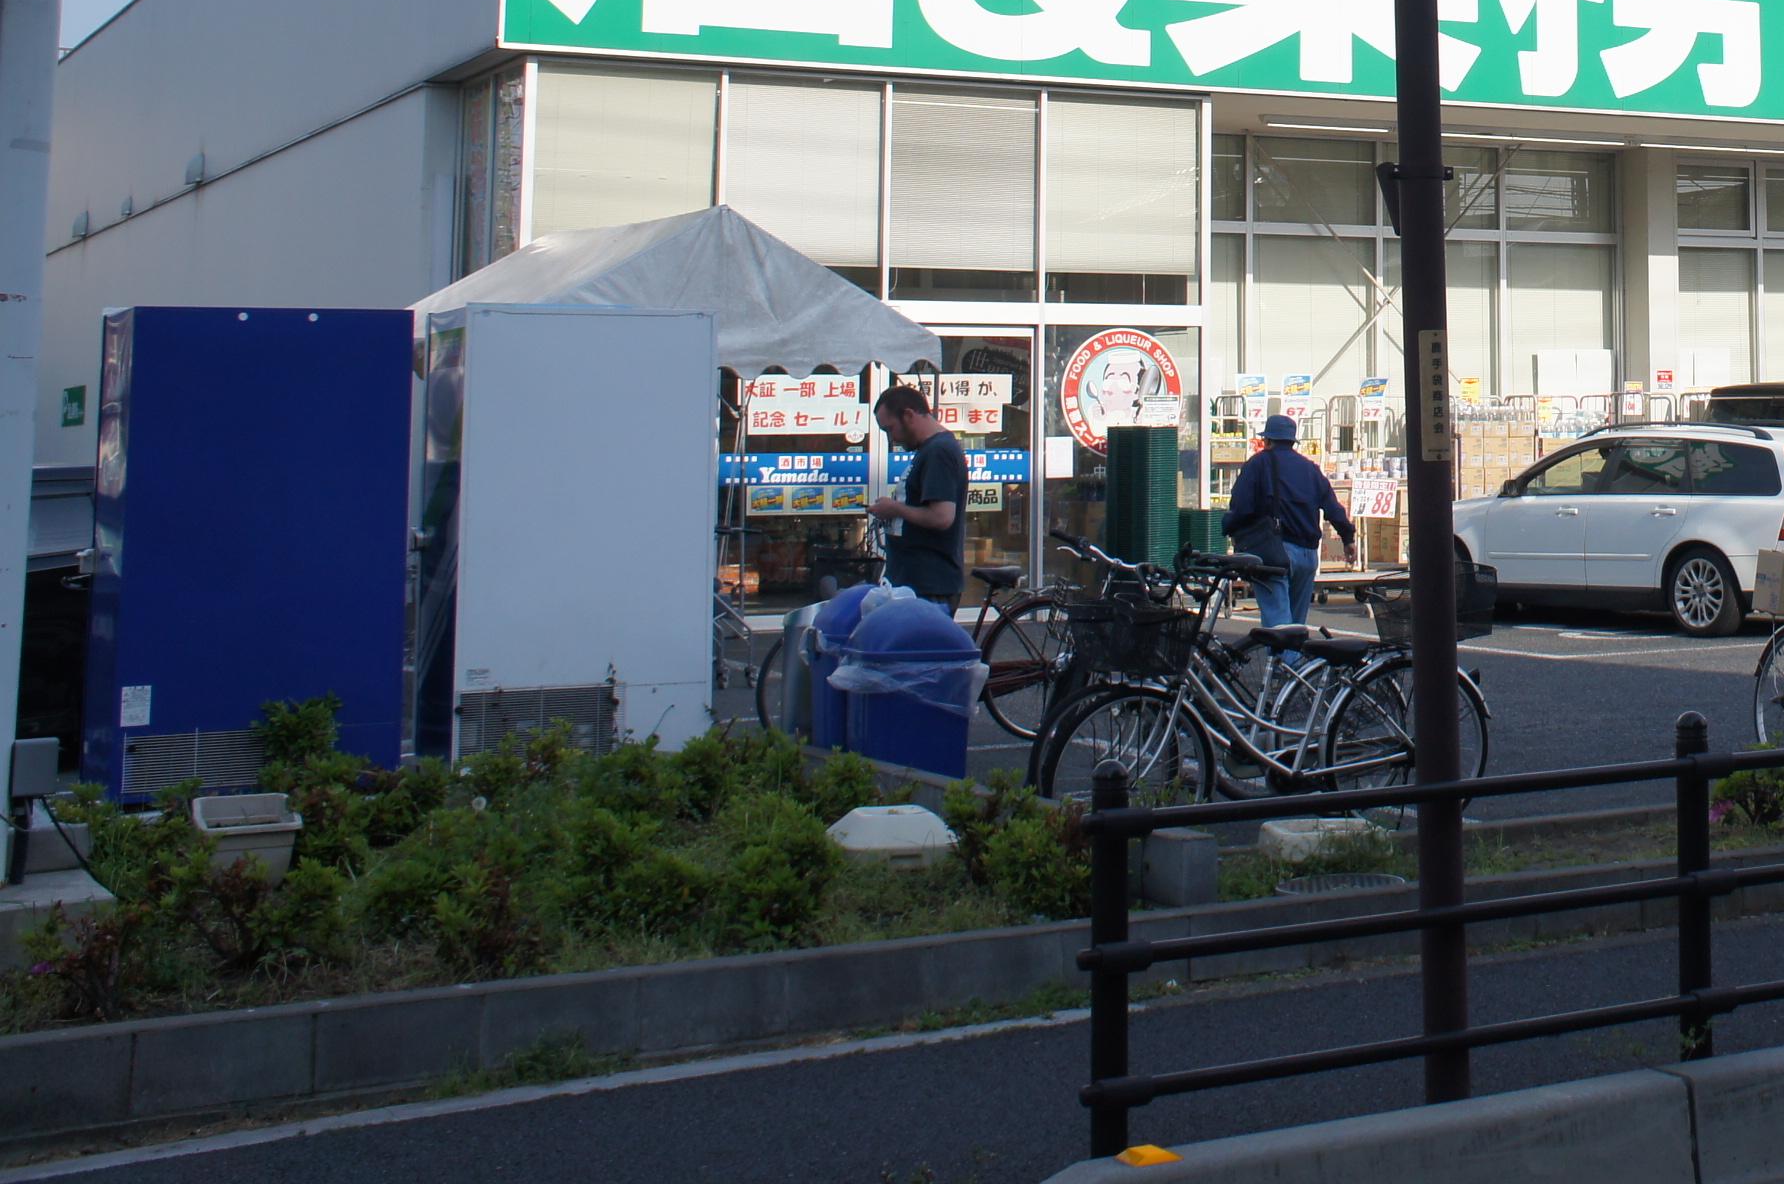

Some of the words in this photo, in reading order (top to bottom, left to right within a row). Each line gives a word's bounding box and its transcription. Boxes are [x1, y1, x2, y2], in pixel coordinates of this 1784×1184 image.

[1069, 348, 1092, 381] FOOD
[1104, 333, 1153, 352] LIQUEUR
[1152, 348, 1176, 379] SHOP
[1286, 406, 1307, 417] 67
[759, 466, 829, 484] Yamada
[1371, 491, 1394, 515] 88
